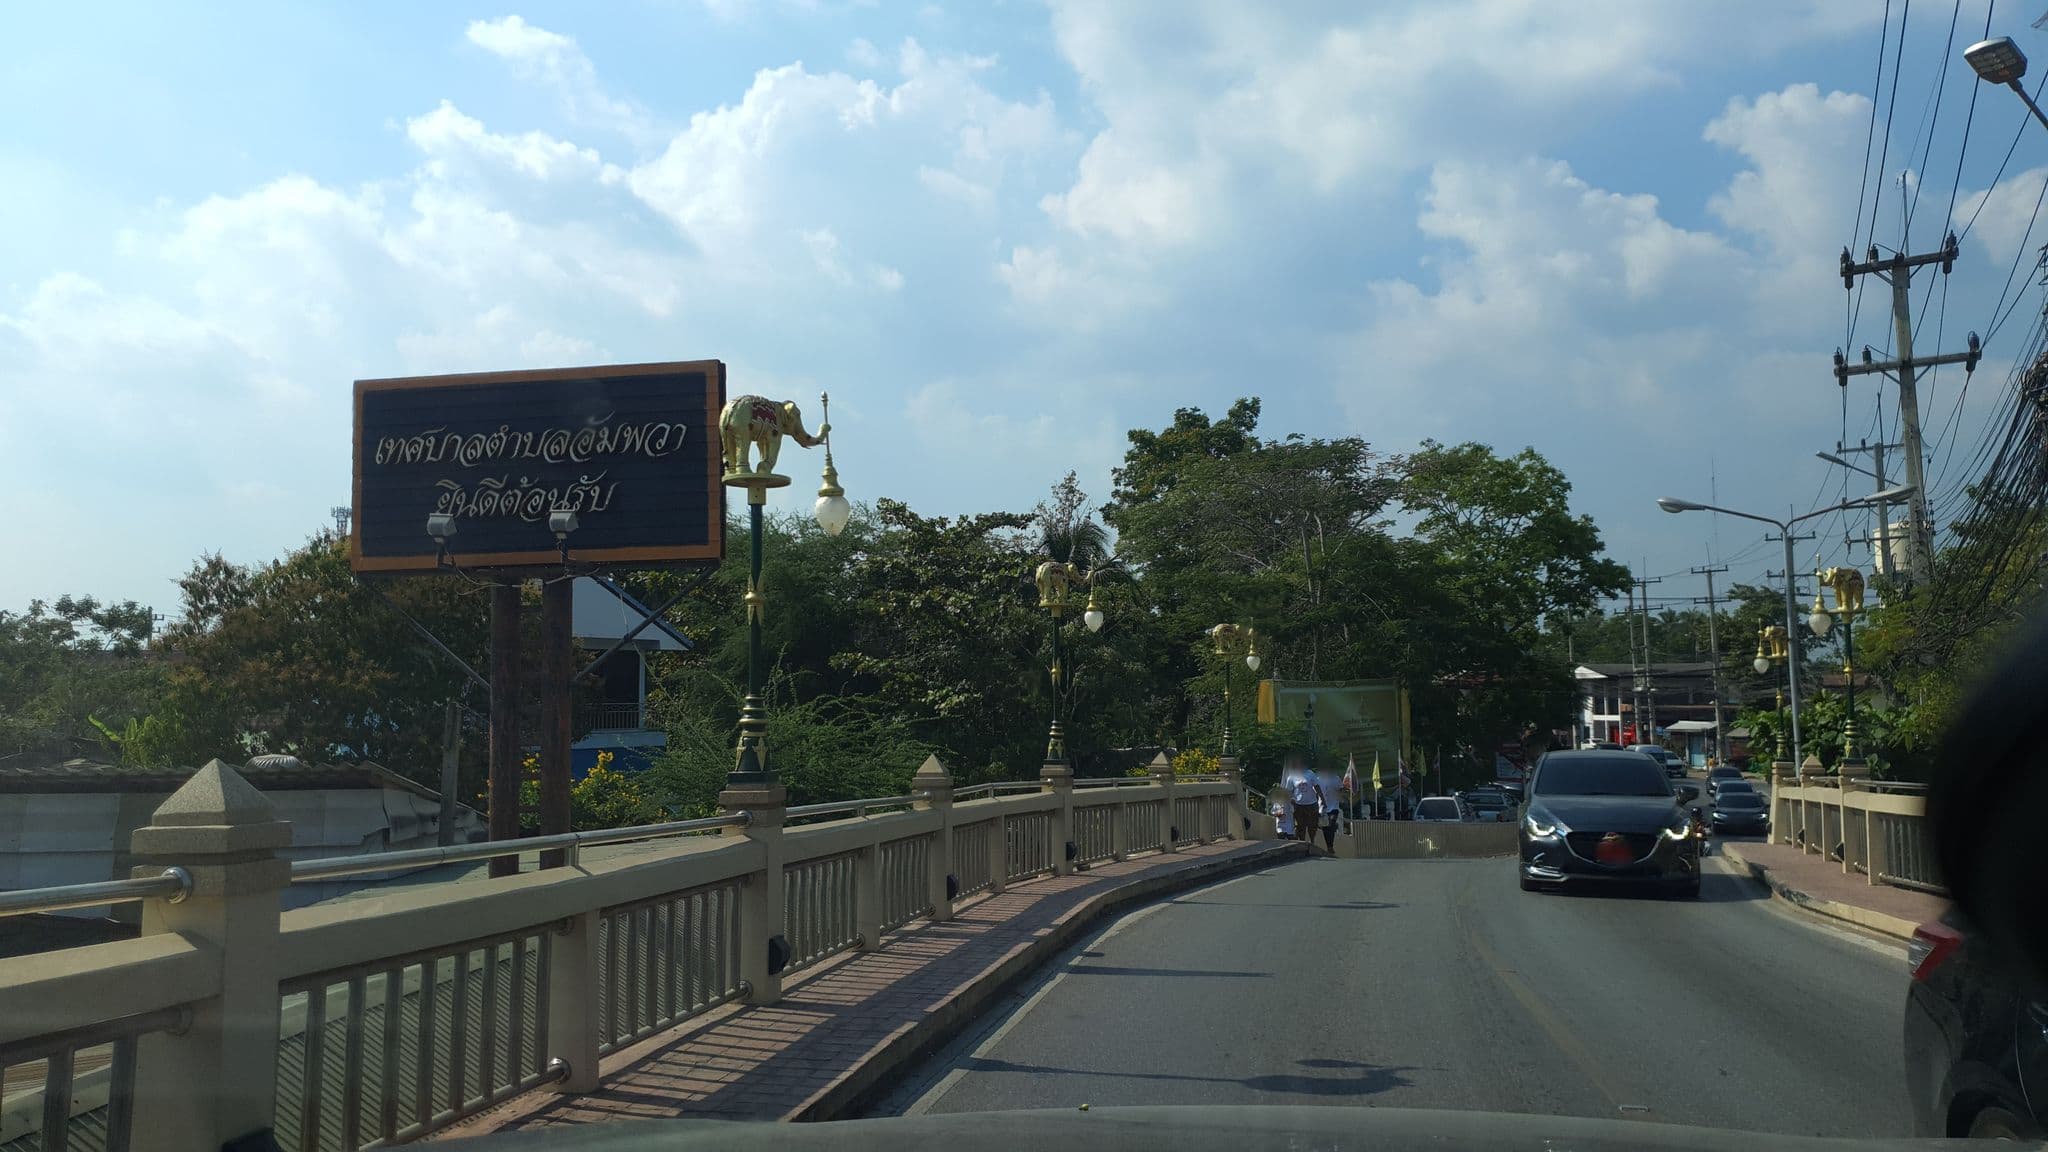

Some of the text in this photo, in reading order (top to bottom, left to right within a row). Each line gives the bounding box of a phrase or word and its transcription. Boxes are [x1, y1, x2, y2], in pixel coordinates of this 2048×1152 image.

[375, 411, 687, 467] เทศบาลตำบลอัมพวา
[435, 470, 620, 522] ยินดีต้อนรับ
